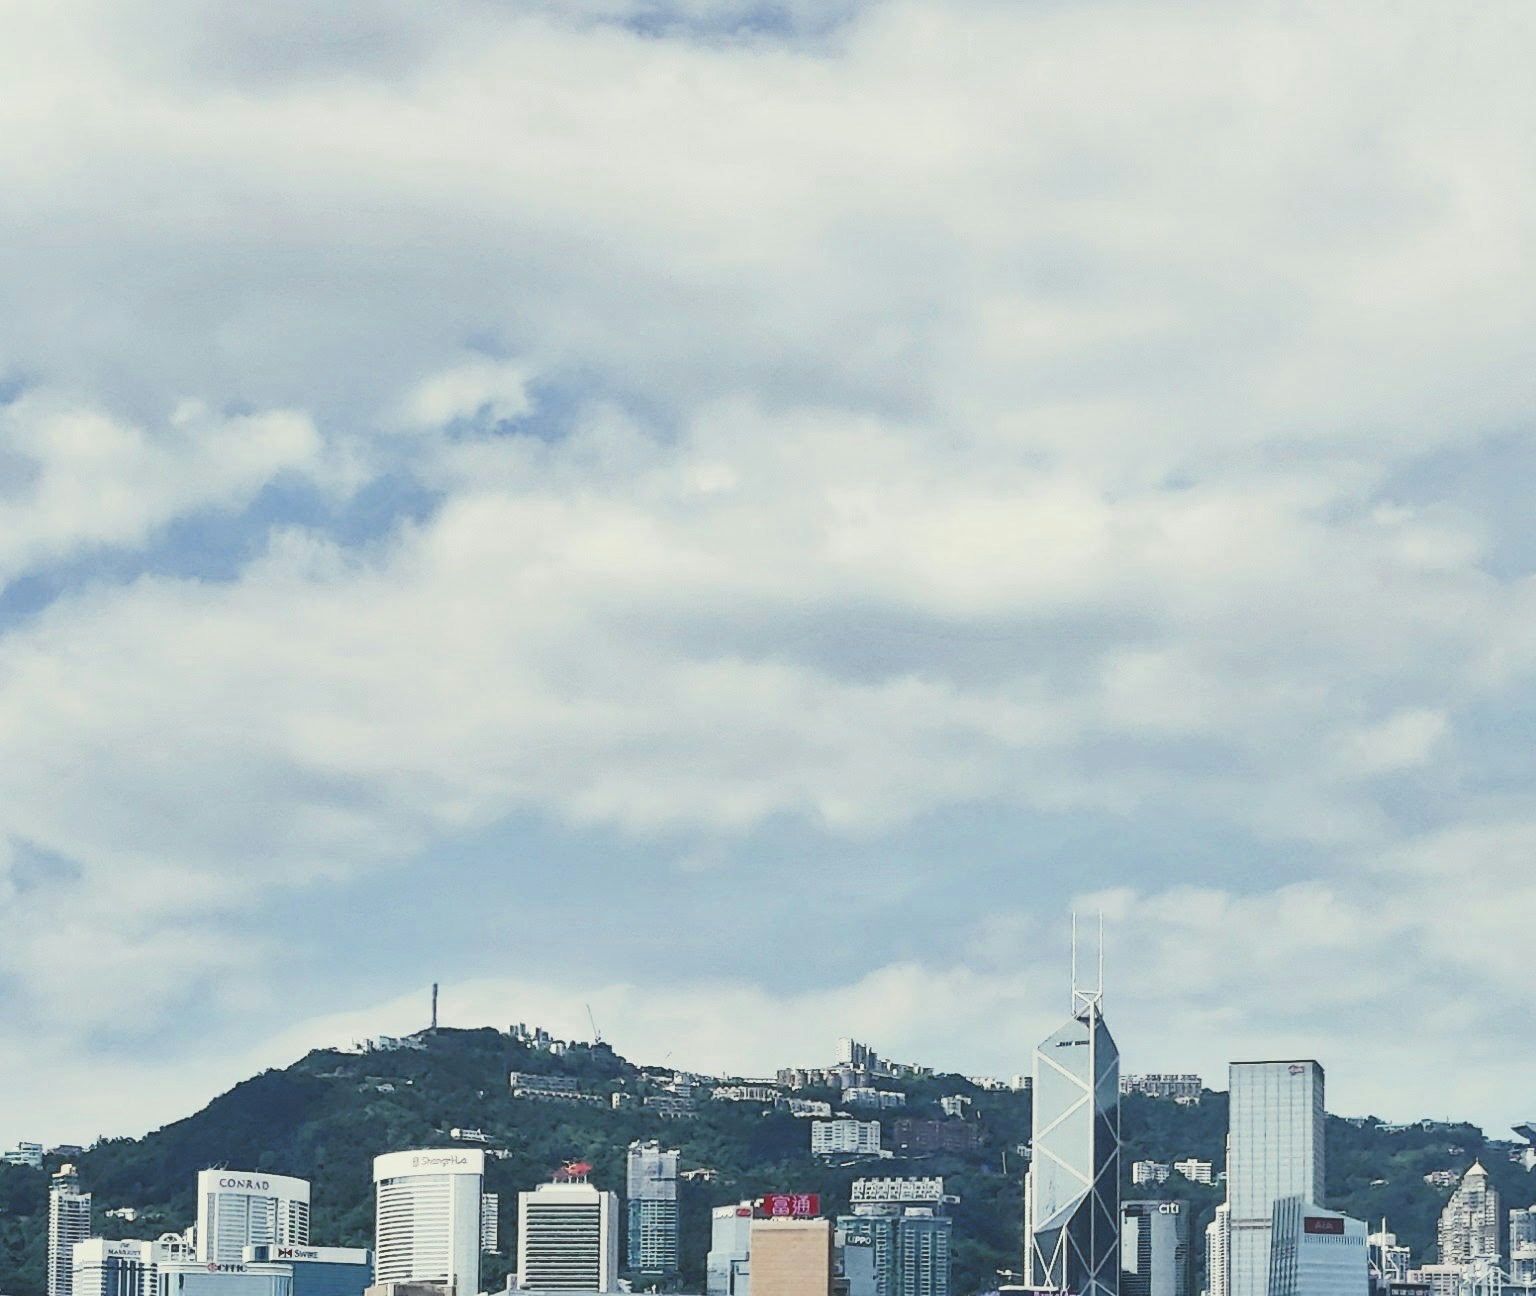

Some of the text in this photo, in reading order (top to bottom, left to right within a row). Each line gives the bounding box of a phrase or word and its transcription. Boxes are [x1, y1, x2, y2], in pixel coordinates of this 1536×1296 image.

[219, 1178, 270, 1191] CONRAD
[772, 1195, 810, 1216] 富通
[1158, 1202, 1180, 1214] citi
[847, 1234, 872, 1246] LIPPO
